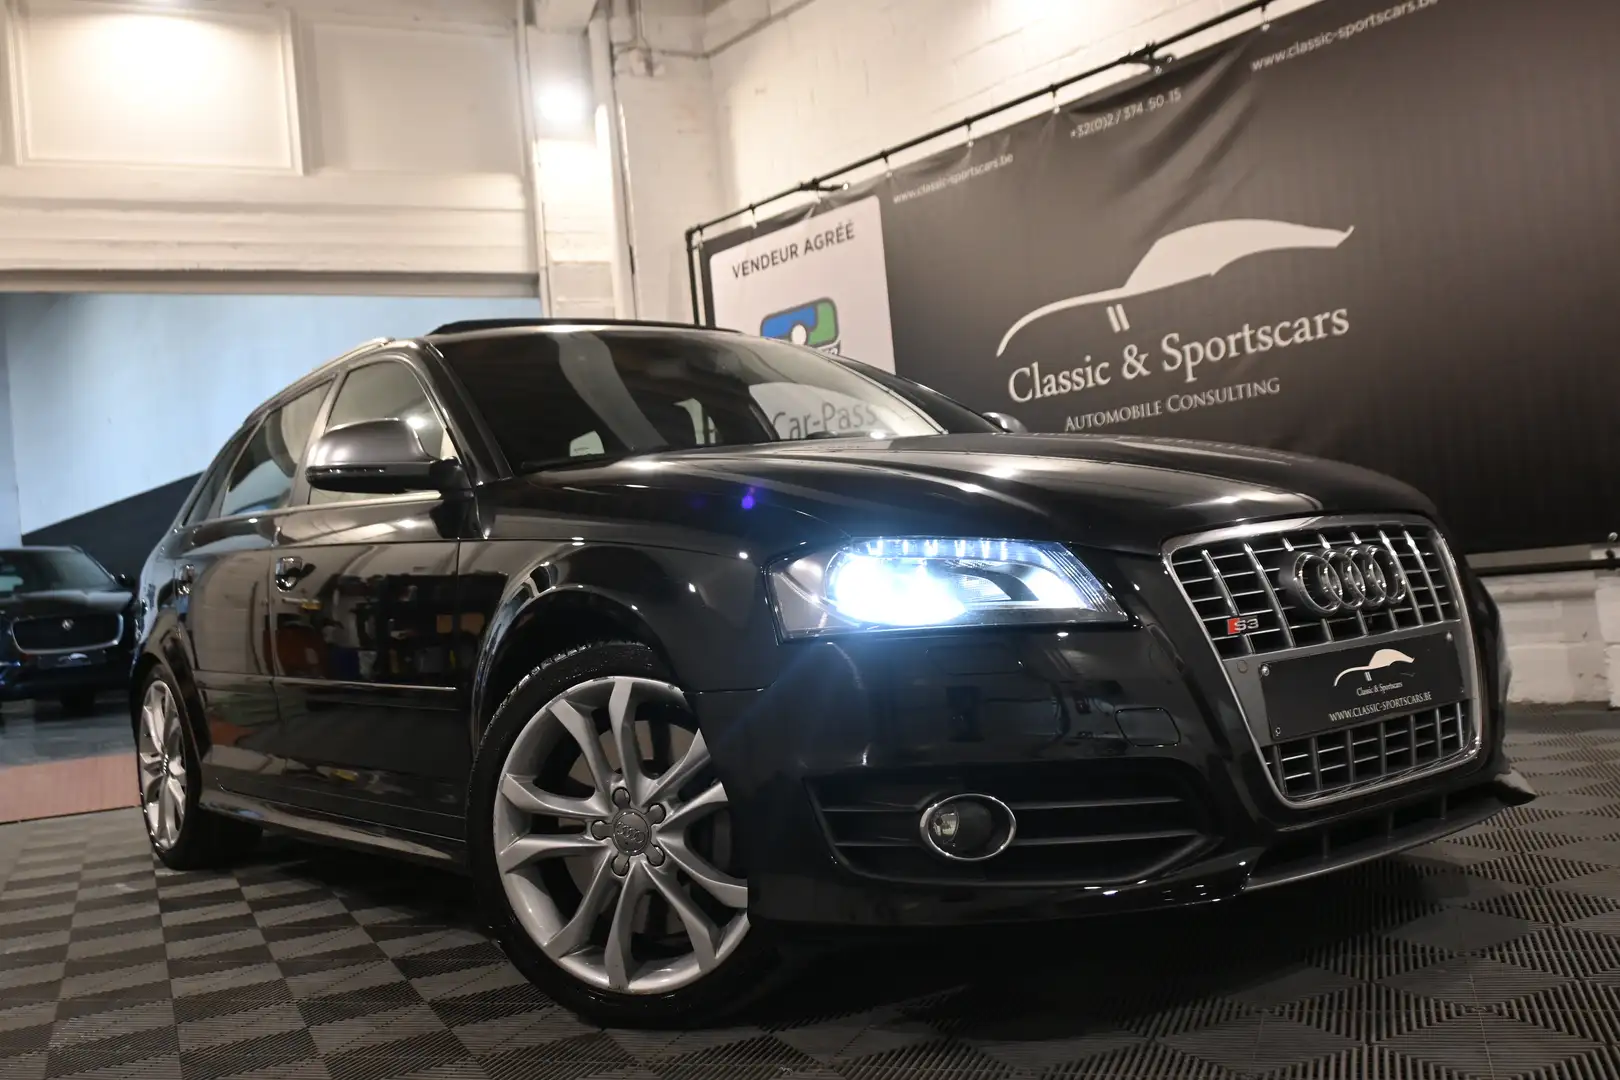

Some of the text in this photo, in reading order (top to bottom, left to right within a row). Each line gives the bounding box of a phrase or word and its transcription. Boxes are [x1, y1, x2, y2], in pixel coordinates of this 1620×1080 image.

[893, 153, 1014, 204] www.classic-sportscars.be
[732, 219, 856, 278] VENDEUR AGRÉÉ
[1008, 308, 1350, 402] Classic & Sportscars
[1064, 377, 1281, 432] AUTOMOBILE CONSULTING
[1234, 618, 1259, 631] S3
[1328, 691, 1432, 721] WWW.CLASSIC-SPORTSCARS.BE
[1356, 686, 1374, 697] Classic
[1379, 681, 1403, 694] Sportscars
